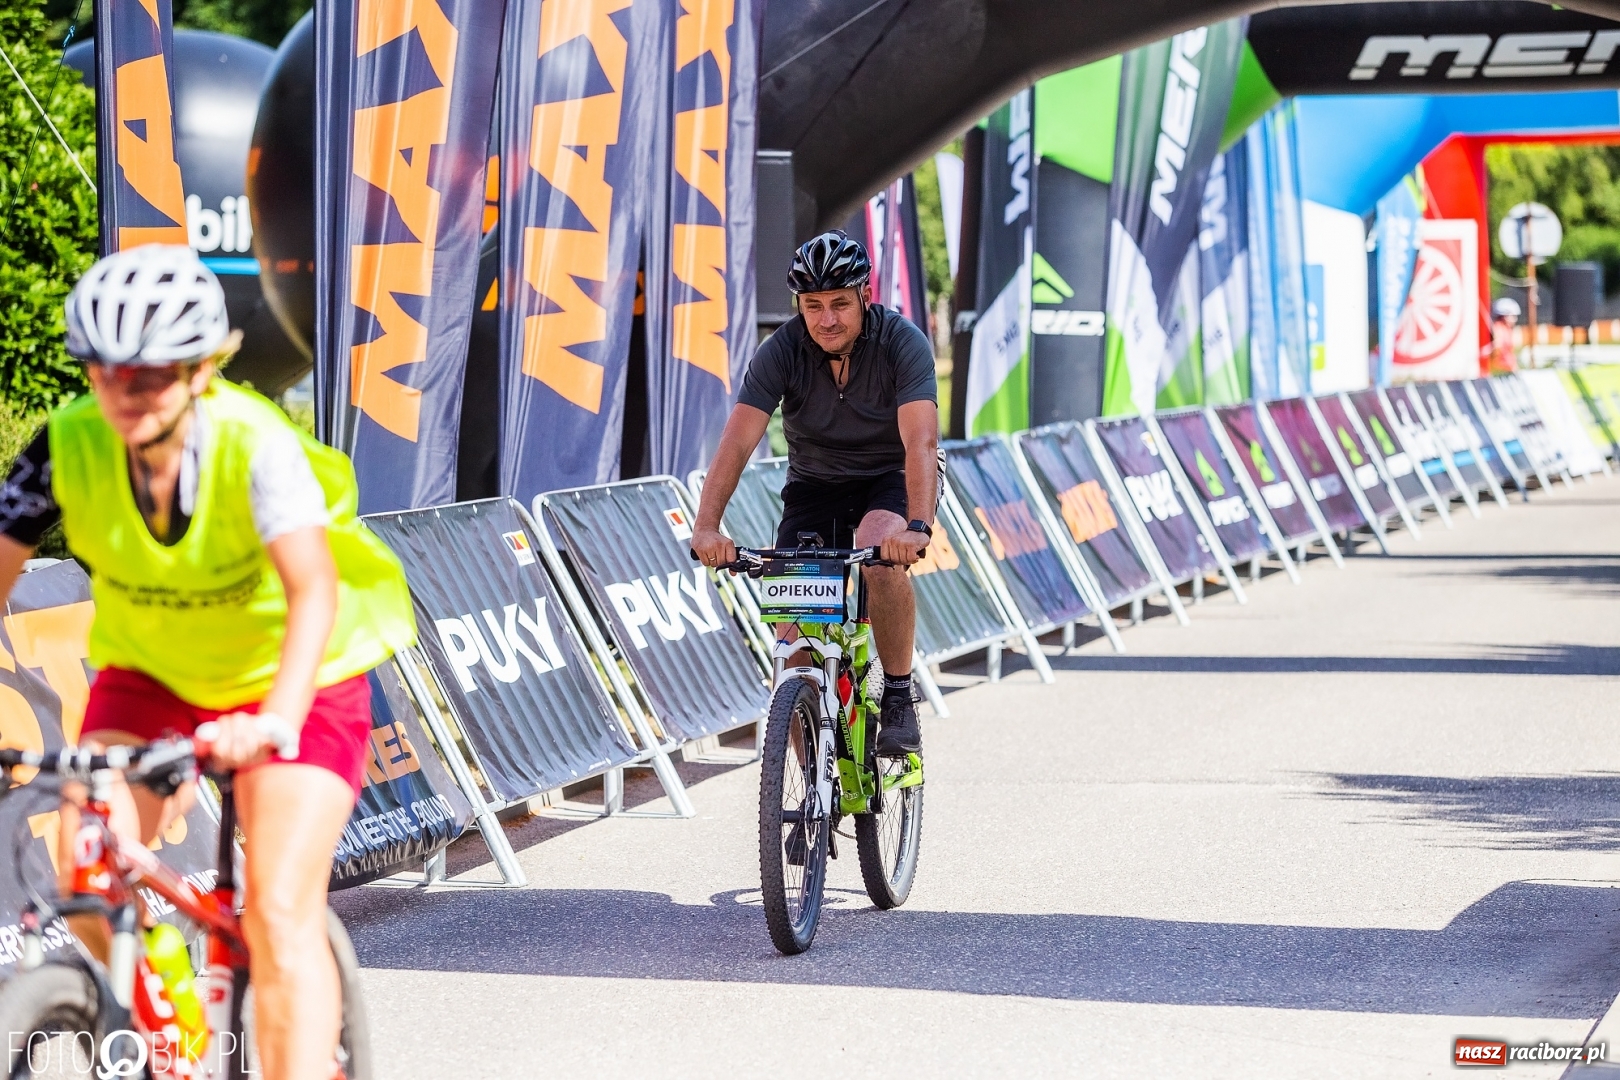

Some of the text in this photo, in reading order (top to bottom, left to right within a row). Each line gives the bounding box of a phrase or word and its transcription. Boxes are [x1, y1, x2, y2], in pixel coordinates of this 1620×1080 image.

[605, 566, 724, 650] PUKY
[768, 584, 837, 597] OPIEKUN
[433, 596, 567, 694] PUKY
[823, 740, 836, 785] FOX
